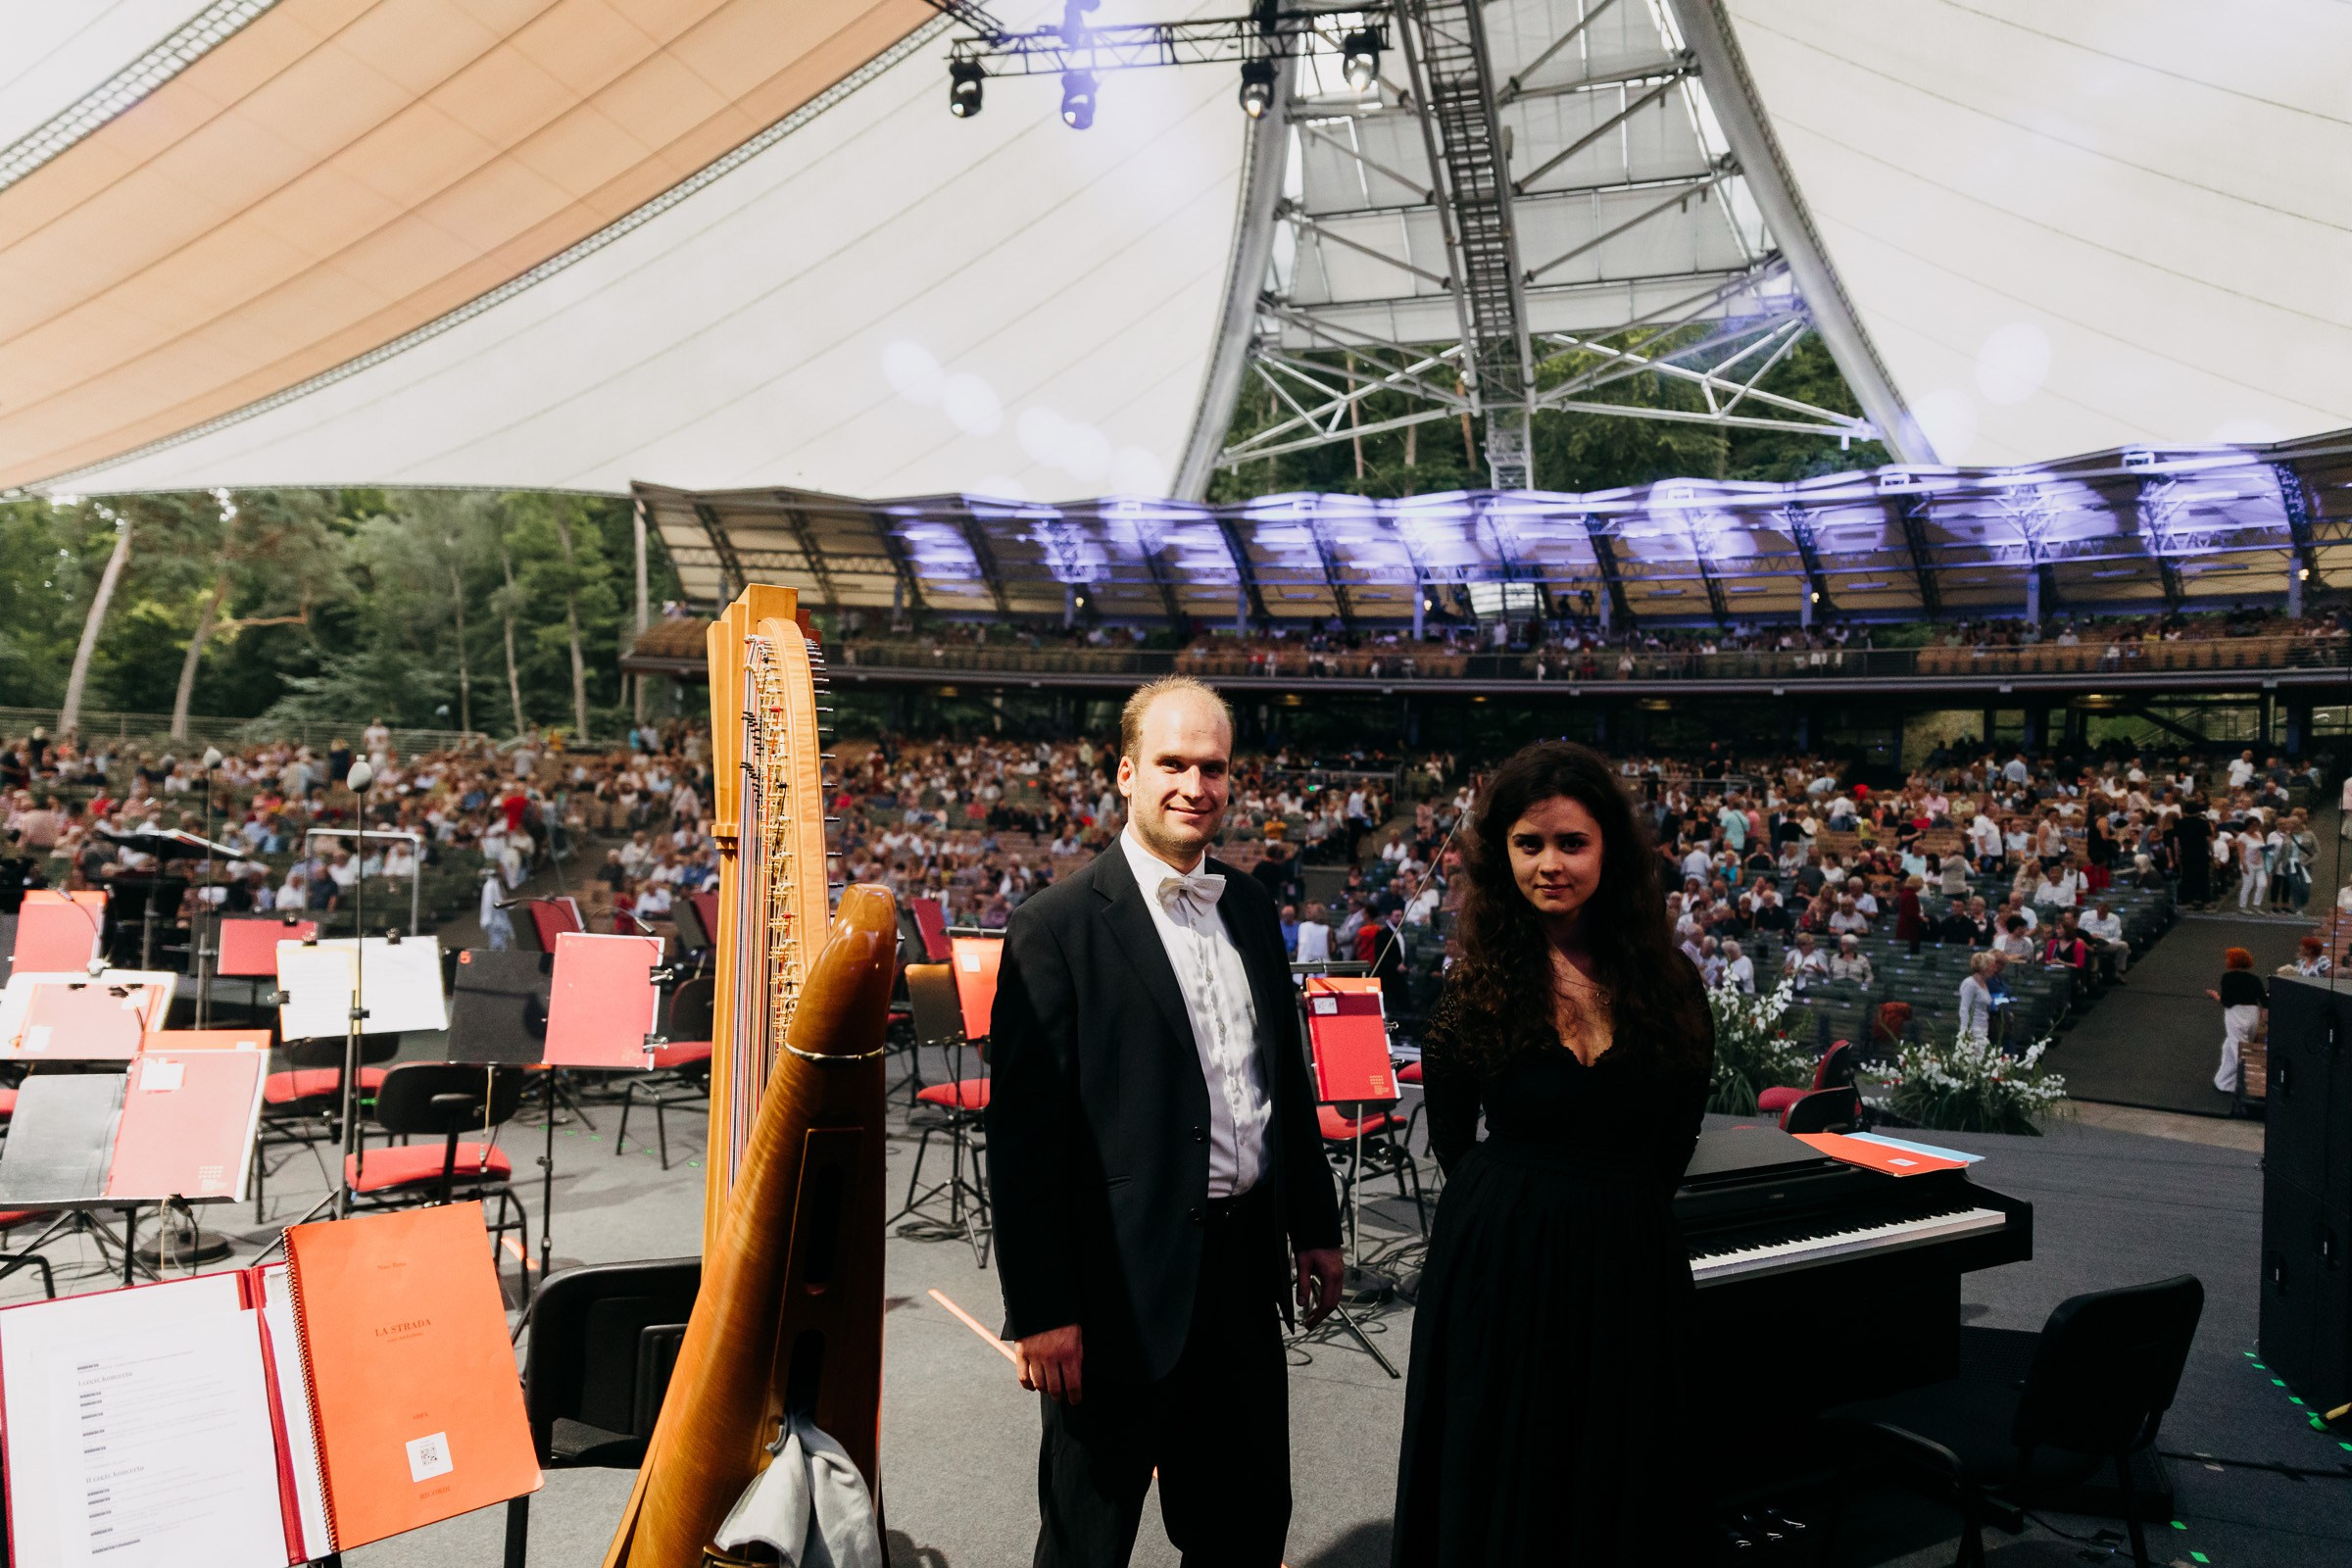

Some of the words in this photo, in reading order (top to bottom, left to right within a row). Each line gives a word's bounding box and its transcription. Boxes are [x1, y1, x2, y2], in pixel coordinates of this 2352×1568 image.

[375, 1327, 388, 1337] LA
[390, 1318, 431, 1334] STRADA
[419, 1485, 451, 1499] RICORDI
